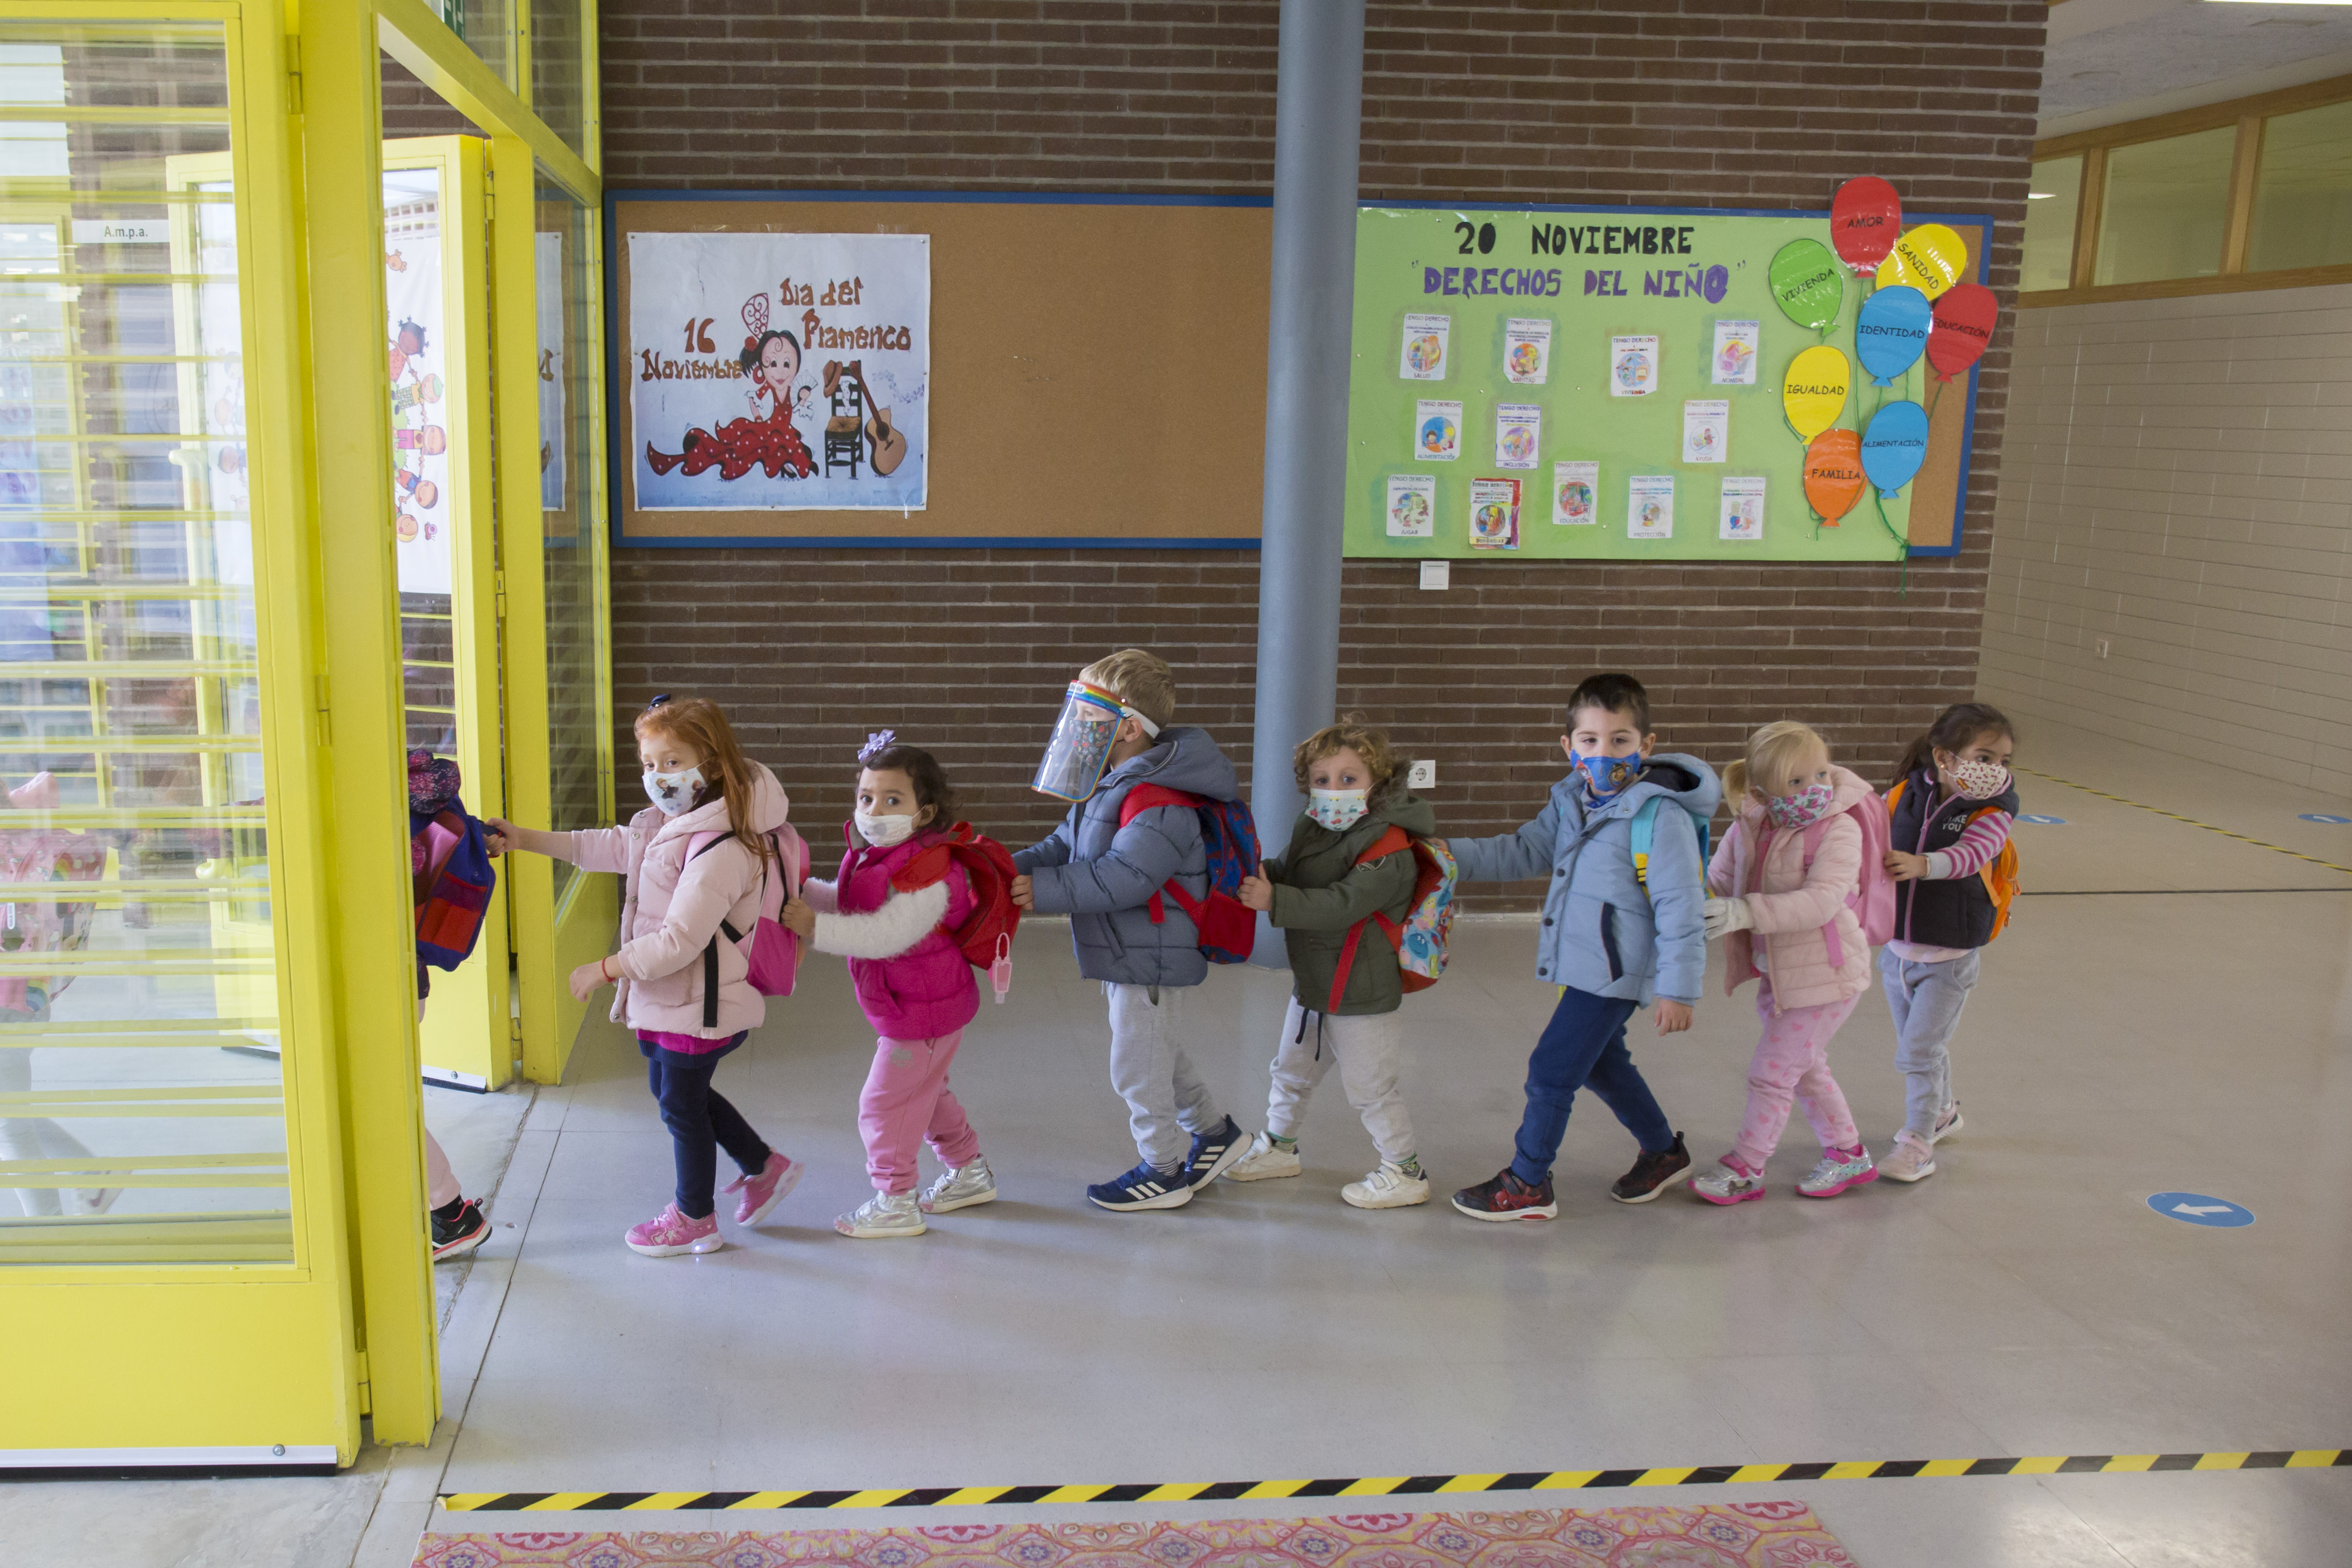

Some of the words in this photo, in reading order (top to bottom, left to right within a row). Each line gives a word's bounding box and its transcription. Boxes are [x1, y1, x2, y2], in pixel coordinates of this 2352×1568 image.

[104, 225, 148, 239] A.m.p.a.
[1848, 216, 1884, 229] AMOR
[1454, 221, 1496, 255] 20
[1532, 223, 1695, 255] NOVIEMBRE
[1898, 243, 1939, 290] SANIDAD
[820, 276, 863, 306] del
[1584, 269, 1628, 296] DEL
[1782, 268, 1835, 301] VIVIENDA
[684, 318, 716, 353] 16
[1859, 325, 1925, 338] IDENTIDAD
[1933, 318, 1989, 339] EDUCACIÓN
[640, 349, 743, 382] Noviembre
[1786, 385, 1845, 395] IGUALDAD
[1861, 438, 1924, 448] ALIMENTACIÓN
[1812, 469, 1861, 479] FAMILIA
[1942, 823, 1962, 832] YOU
